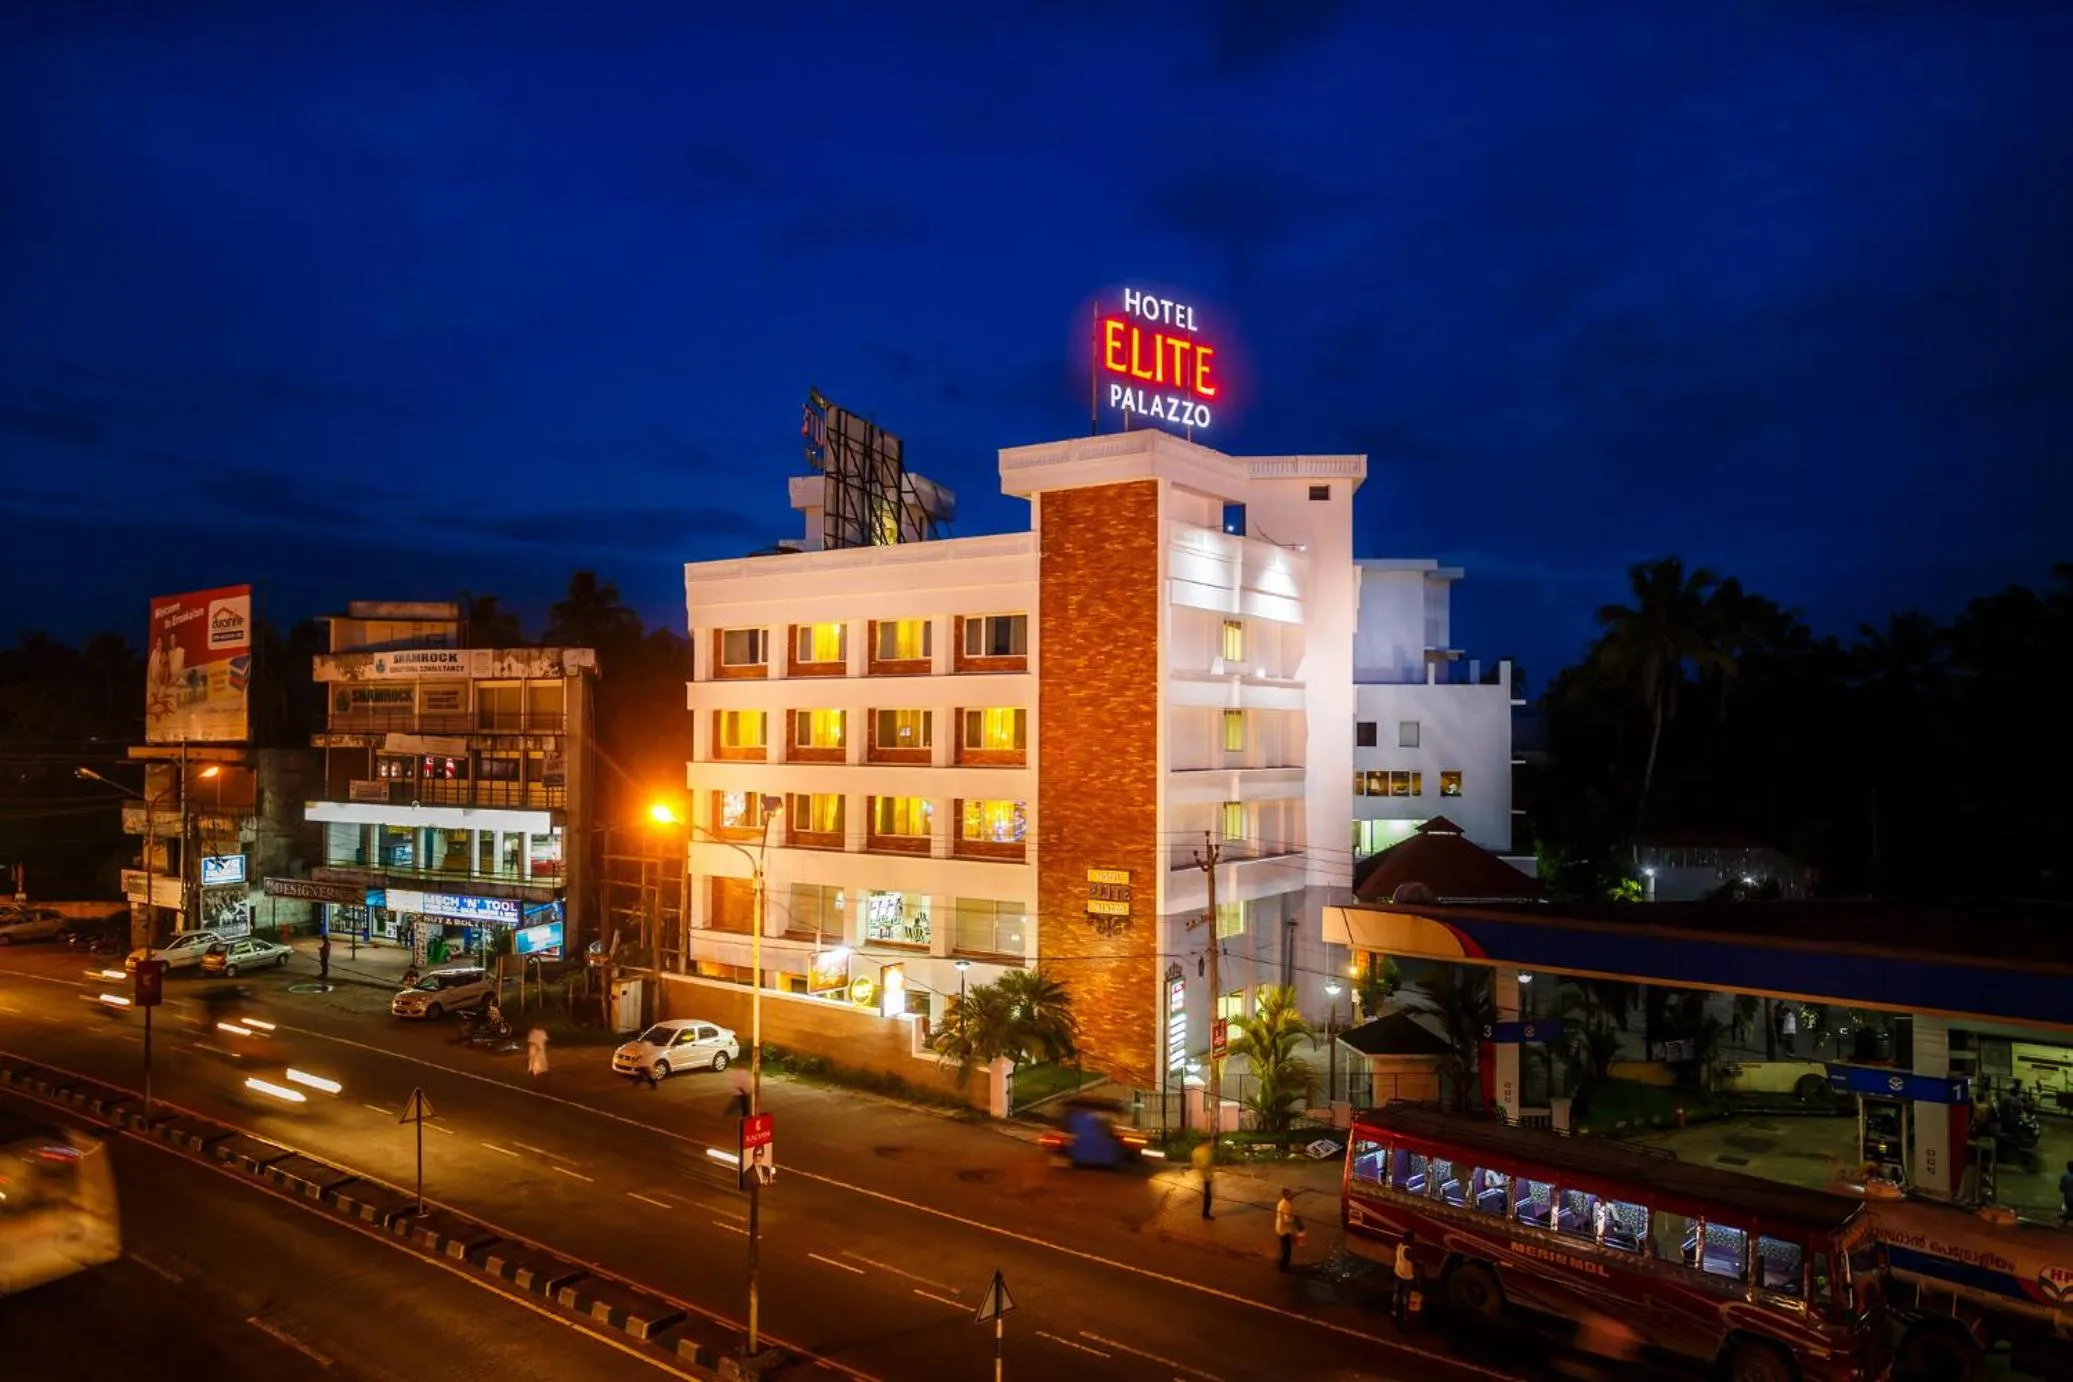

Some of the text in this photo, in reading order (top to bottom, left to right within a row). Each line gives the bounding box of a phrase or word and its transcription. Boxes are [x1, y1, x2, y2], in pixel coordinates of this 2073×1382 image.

[1124, 287, 1198, 332] HOTEL
[1105, 319, 1216, 397] ELITE
[1110, 384, 1212, 428] PALAZZO
[393, 652, 458, 664] SHAMROCK
[424, 894, 459, 907] MECH
[485, 900, 518, 912] TOOL
[1482, 1023, 1493, 1039] 3
[1951, 1083, 1962, 1101] 1
